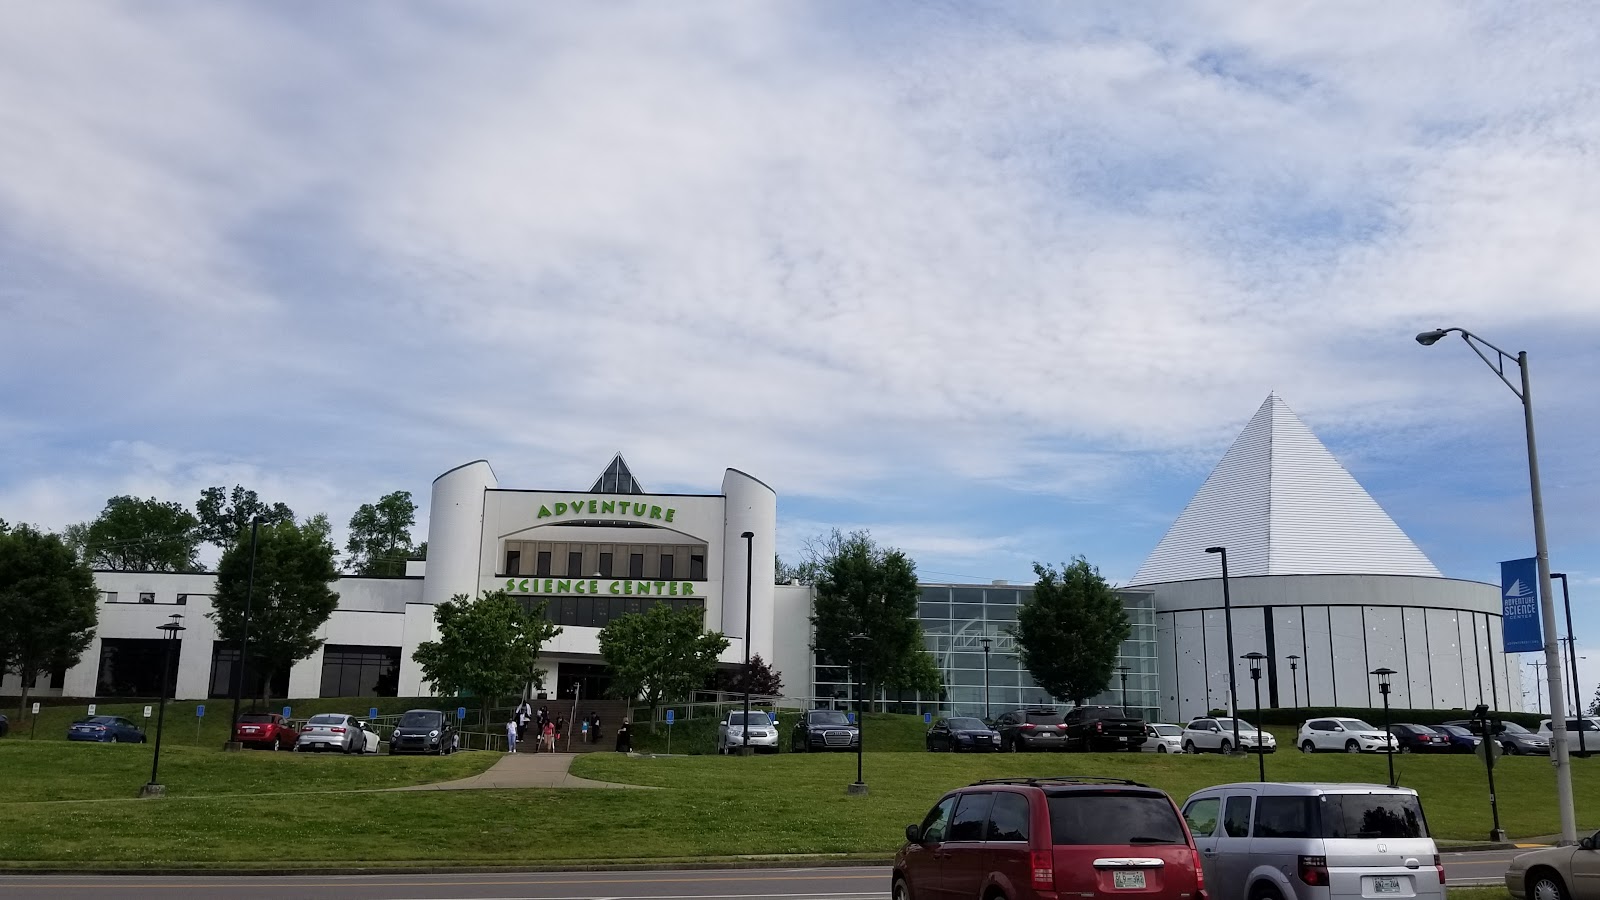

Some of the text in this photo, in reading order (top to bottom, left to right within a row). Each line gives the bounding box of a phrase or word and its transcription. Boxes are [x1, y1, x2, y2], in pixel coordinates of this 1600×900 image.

[537, 499, 676, 523] ADVENTURE
[506, 578, 695, 596] SCIENCE CENTER
[1504, 597, 1535, 606] ADVENTURE
[1504, 604, 1535, 615] SCIENCE
